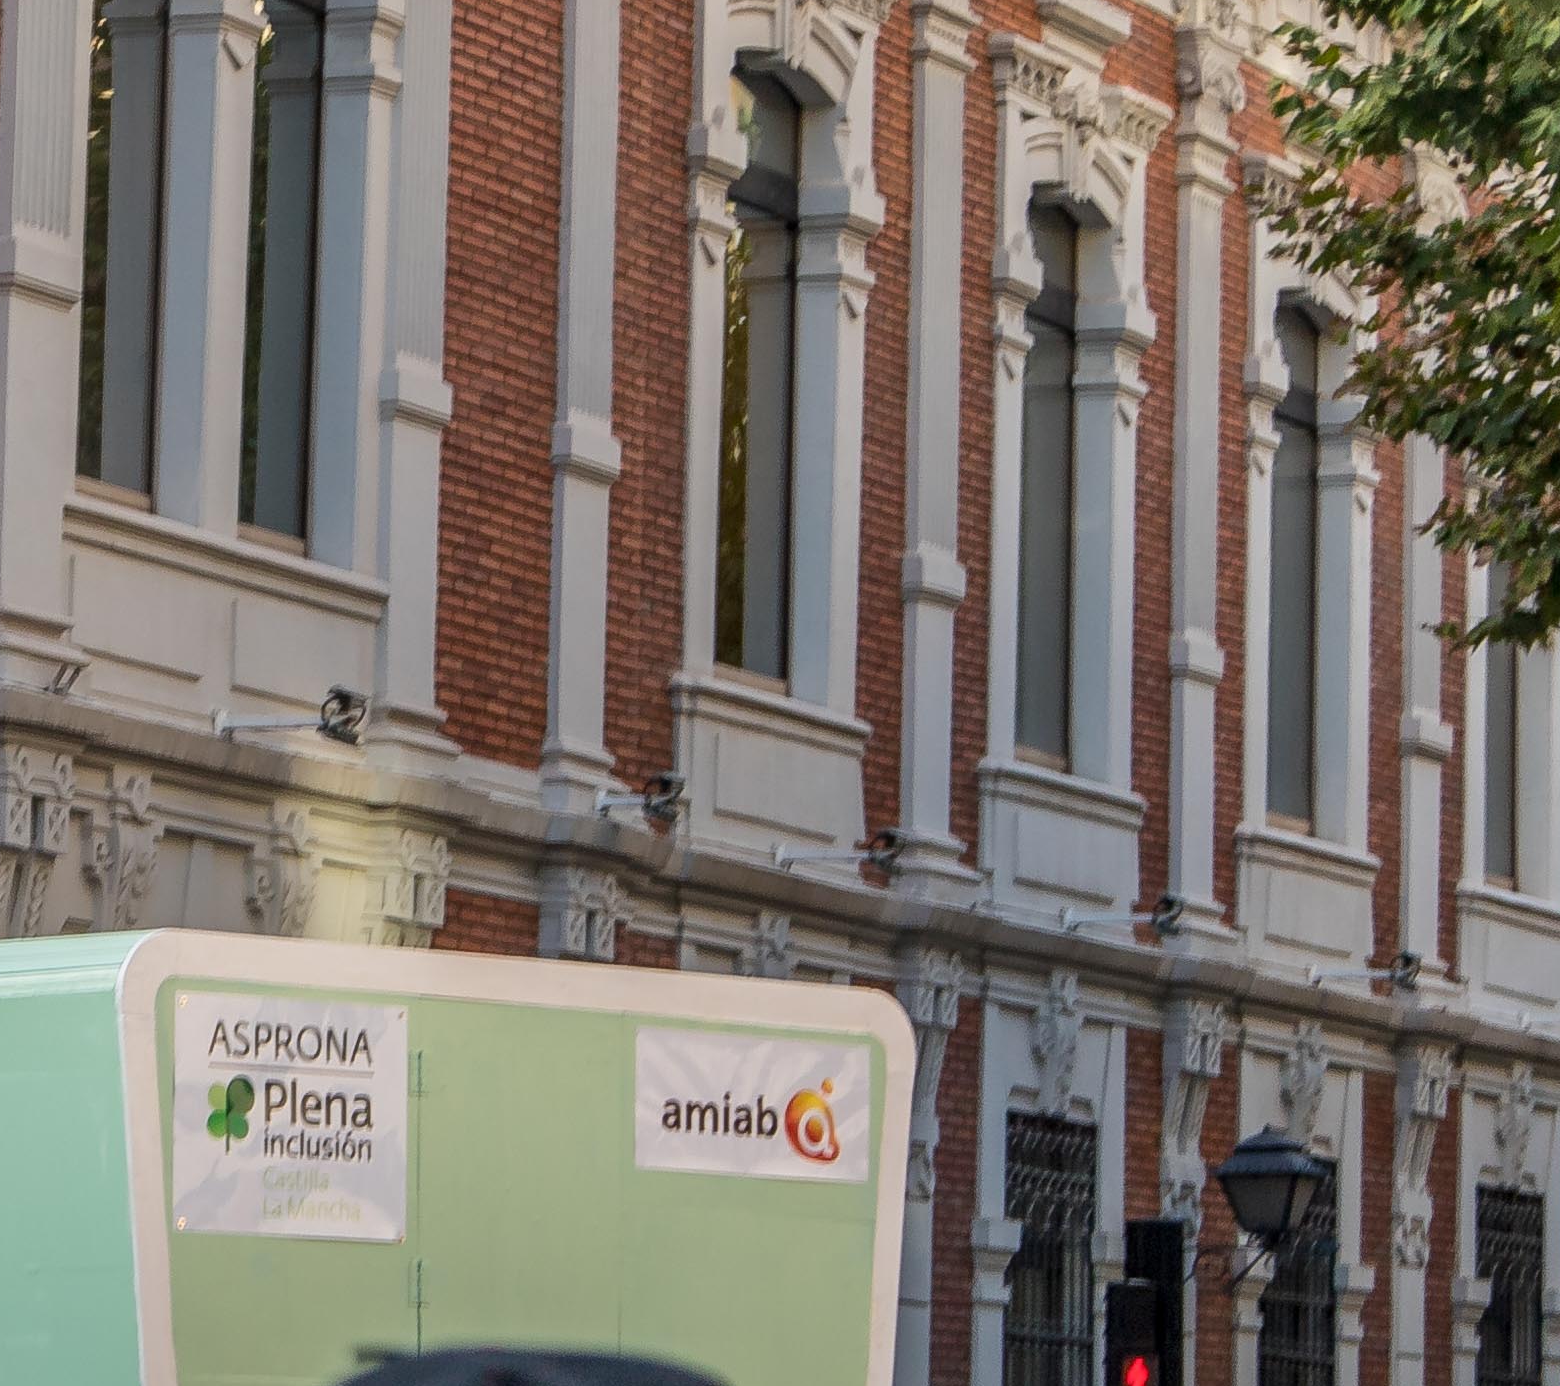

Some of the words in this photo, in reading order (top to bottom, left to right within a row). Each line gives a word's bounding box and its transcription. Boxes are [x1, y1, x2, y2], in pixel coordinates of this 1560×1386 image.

[207, 1018, 374, 1067] ASPRONA
[264, 1077, 374, 1132] Plena
[661, 1090, 779, 1138] amiab
[263, 1126, 373, 1163] inclusión
[261, 1165, 330, 1192] Castilla
[262, 1197, 282, 1221] La
[286, 1195, 361, 1223] Mancha
